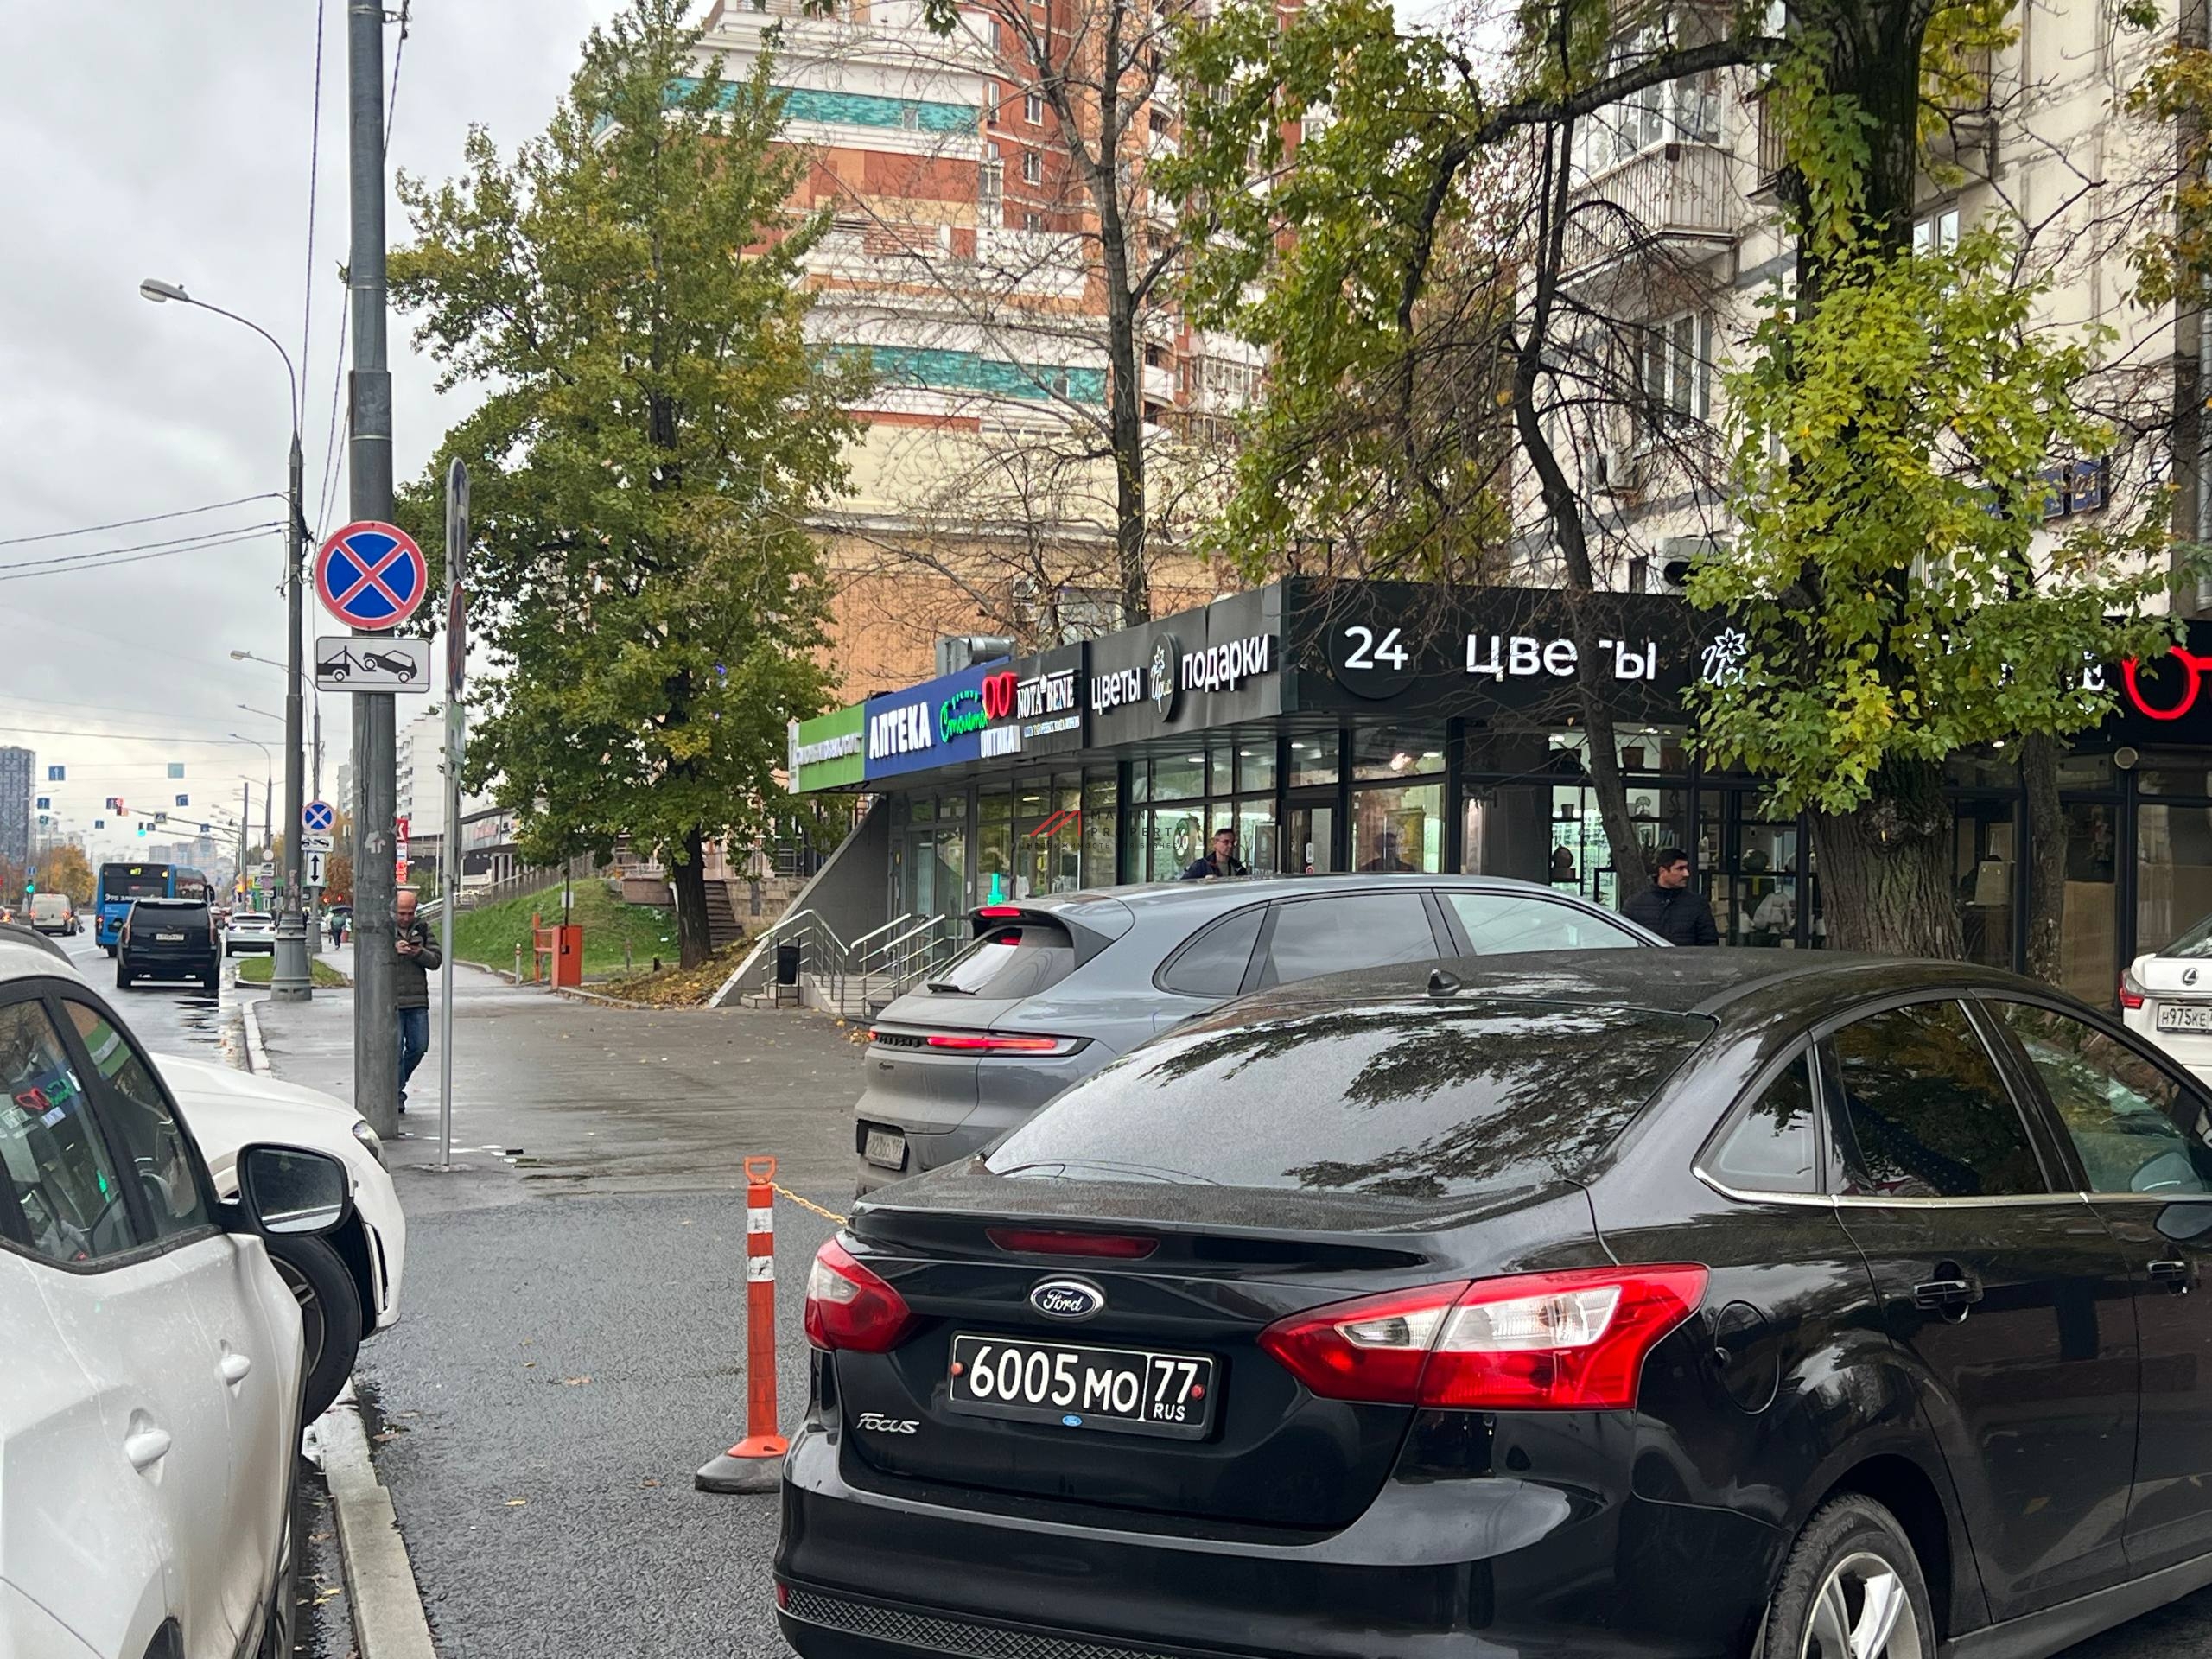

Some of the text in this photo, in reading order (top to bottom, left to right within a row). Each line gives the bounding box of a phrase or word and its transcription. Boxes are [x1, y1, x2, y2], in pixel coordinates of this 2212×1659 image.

[1090, 634, 1269, 715] цветы подарки
[1344, 626, 1656, 683] 24 цвеы
[1017, 684, 1043, 720] NOTA
[1046, 676, 1075, 712] BENE
[868, 702, 932, 760] АПТЕКА
[1042, 1288, 1083, 1313] Ford
[1154, 1360, 1198, 1404] 77
[1154, 1402, 1186, 1421] RUS
